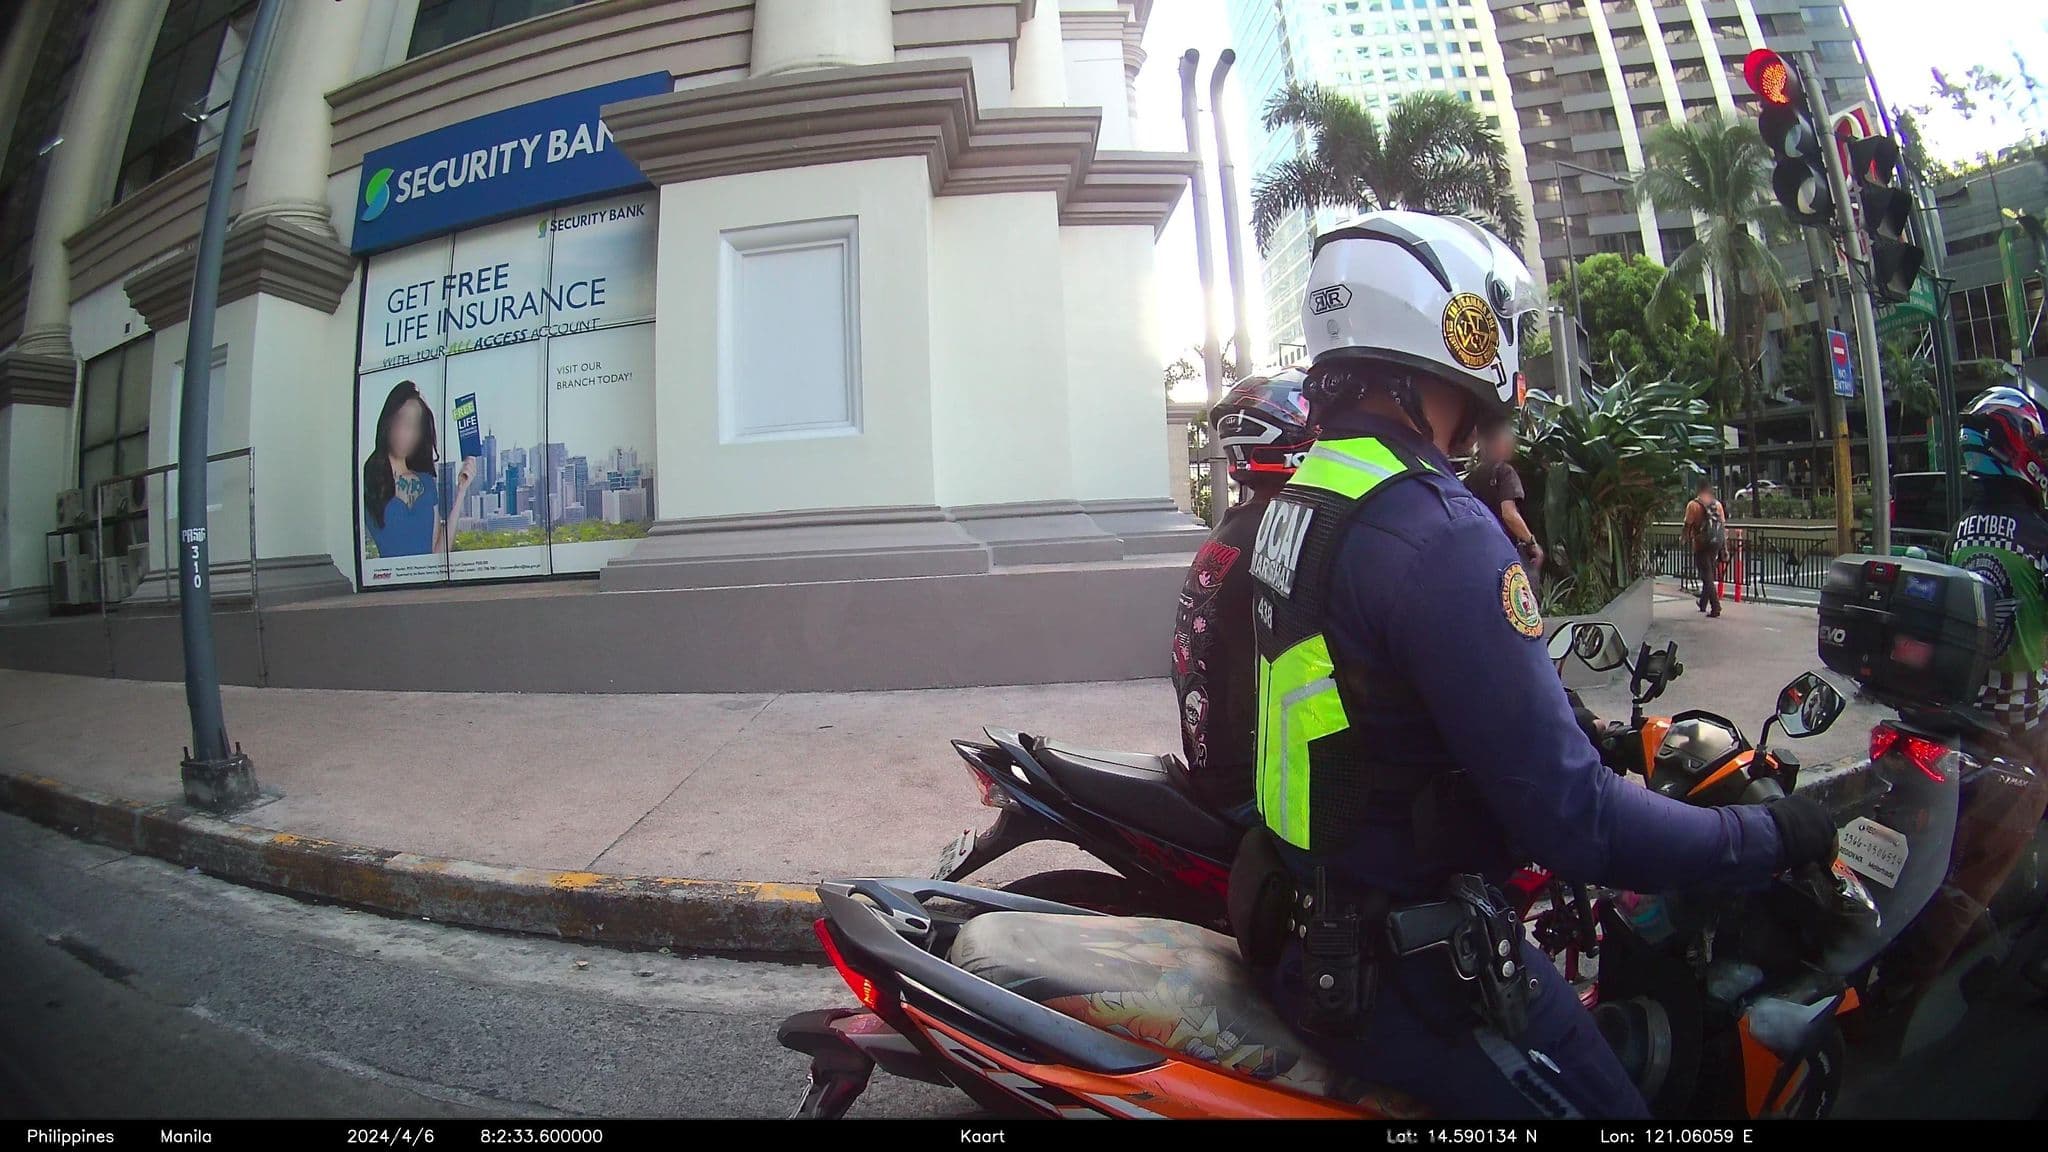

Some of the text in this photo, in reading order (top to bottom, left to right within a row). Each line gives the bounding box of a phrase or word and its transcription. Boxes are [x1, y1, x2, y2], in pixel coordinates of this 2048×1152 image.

[395, 120, 614, 203] SECURITY BAN
[550, 203, 646, 233] SECURITY BANK
[387, 263, 510, 314] GET FREE
[385, 278, 607, 347] LIFE INSURANCE
[473, 328, 528, 350] ACCESS
[531, 318, 601, 339] ACCOUNT
[556, 372, 633, 390] BRANCH TODAY!
[557, 361, 602, 375] VISIT OUR
[458, 415, 477, 430] LIFE
[1956, 514, 2017, 540] MEMBER
